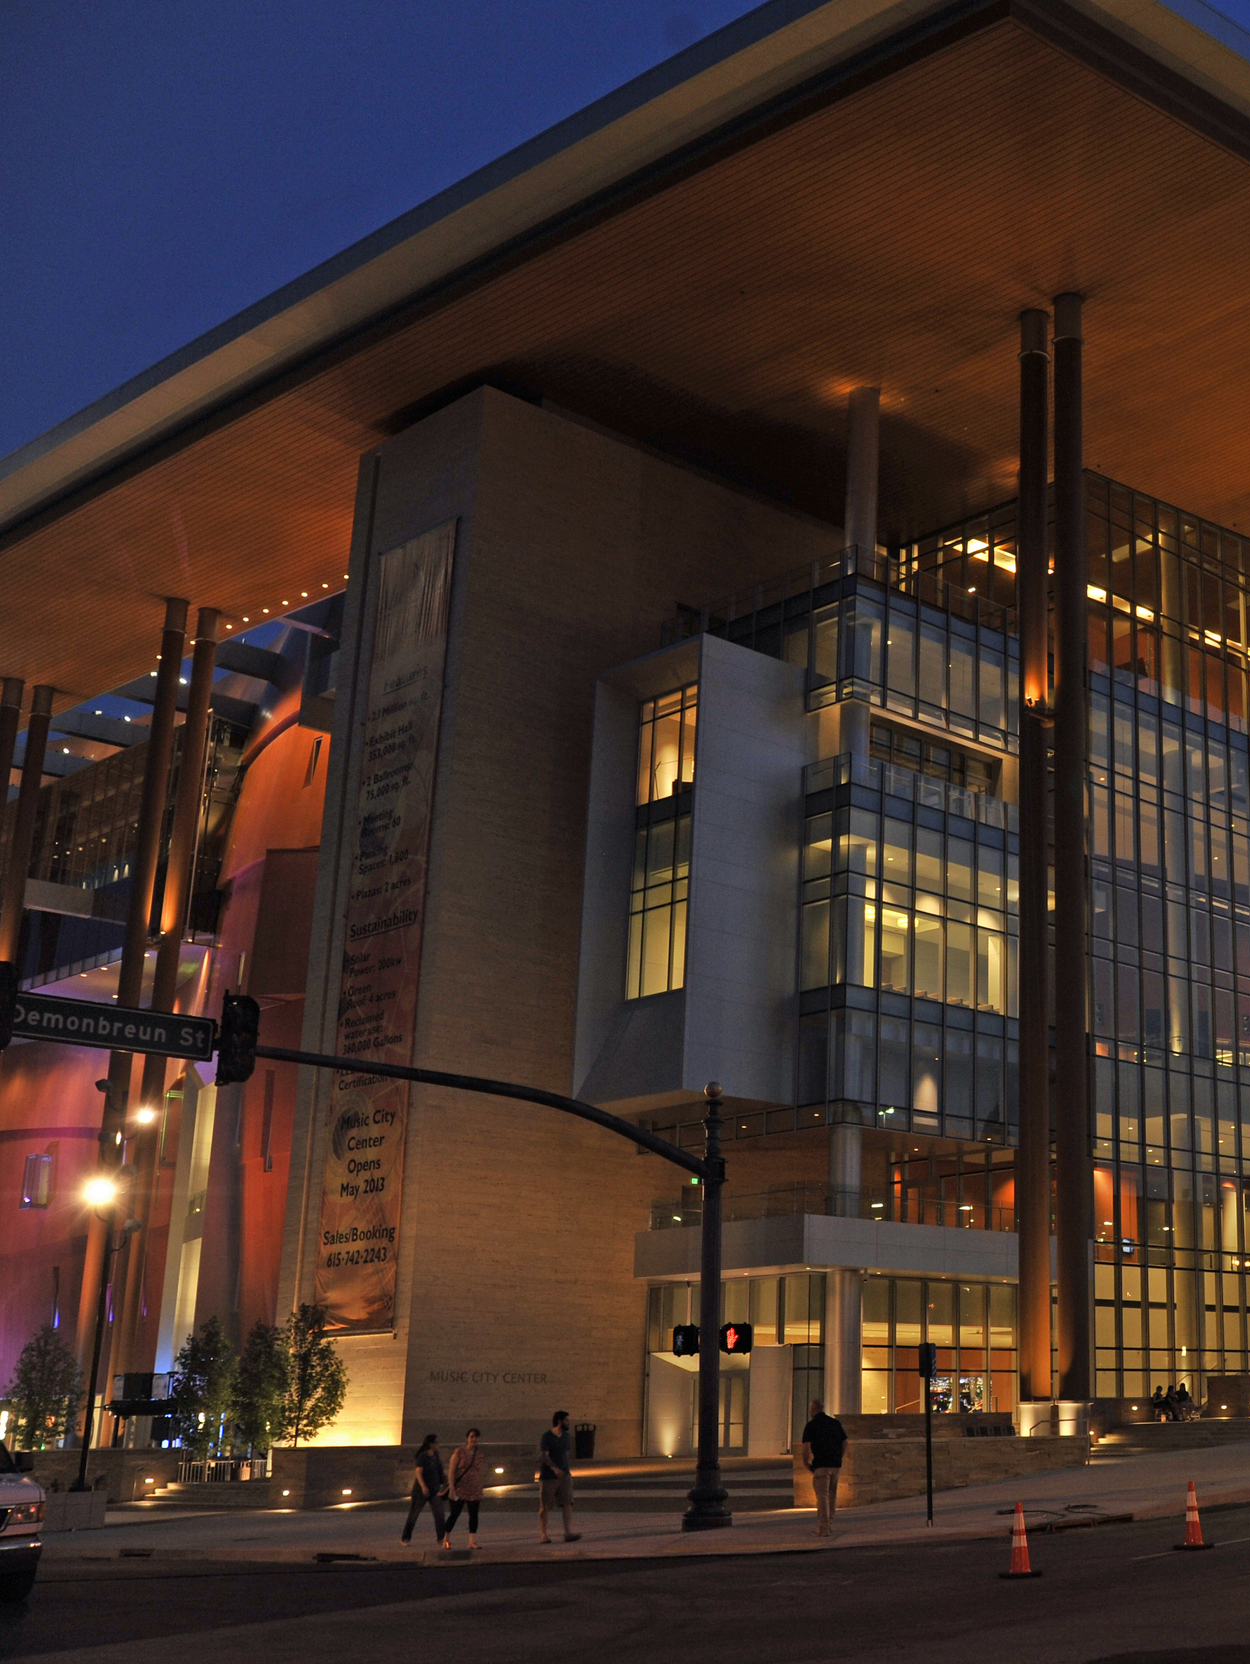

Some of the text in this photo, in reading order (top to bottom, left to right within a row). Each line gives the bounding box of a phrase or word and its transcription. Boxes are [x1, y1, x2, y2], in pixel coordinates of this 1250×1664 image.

[369, 721, 413, 747] Exhibit Hall
[363, 809, 393, 826] Meeting
[391, 876, 411, 891] acres
[350, 908, 419, 938] Sustainability
[349, 952, 371, 966] Solar
[347, 984, 372, 997] Green
[375, 990, 396, 1002] acres
[345, 1010, 384, 1029] Reclaimed
[179, 1028, 205, 1049] St
[344, 1028, 366, 1041] water
[373, 1034, 402, 1048] Gallons
[340, 1108, 396, 1130] Music City
[347, 1135, 385, 1151] Center
[347, 1158, 381, 1177] Opens
[340, 1176, 385, 1200] May 2013
[323, 1223, 396, 1246] Sales/Booking
[429, 1371, 548, 1384] MUSIC CITY CENTER
